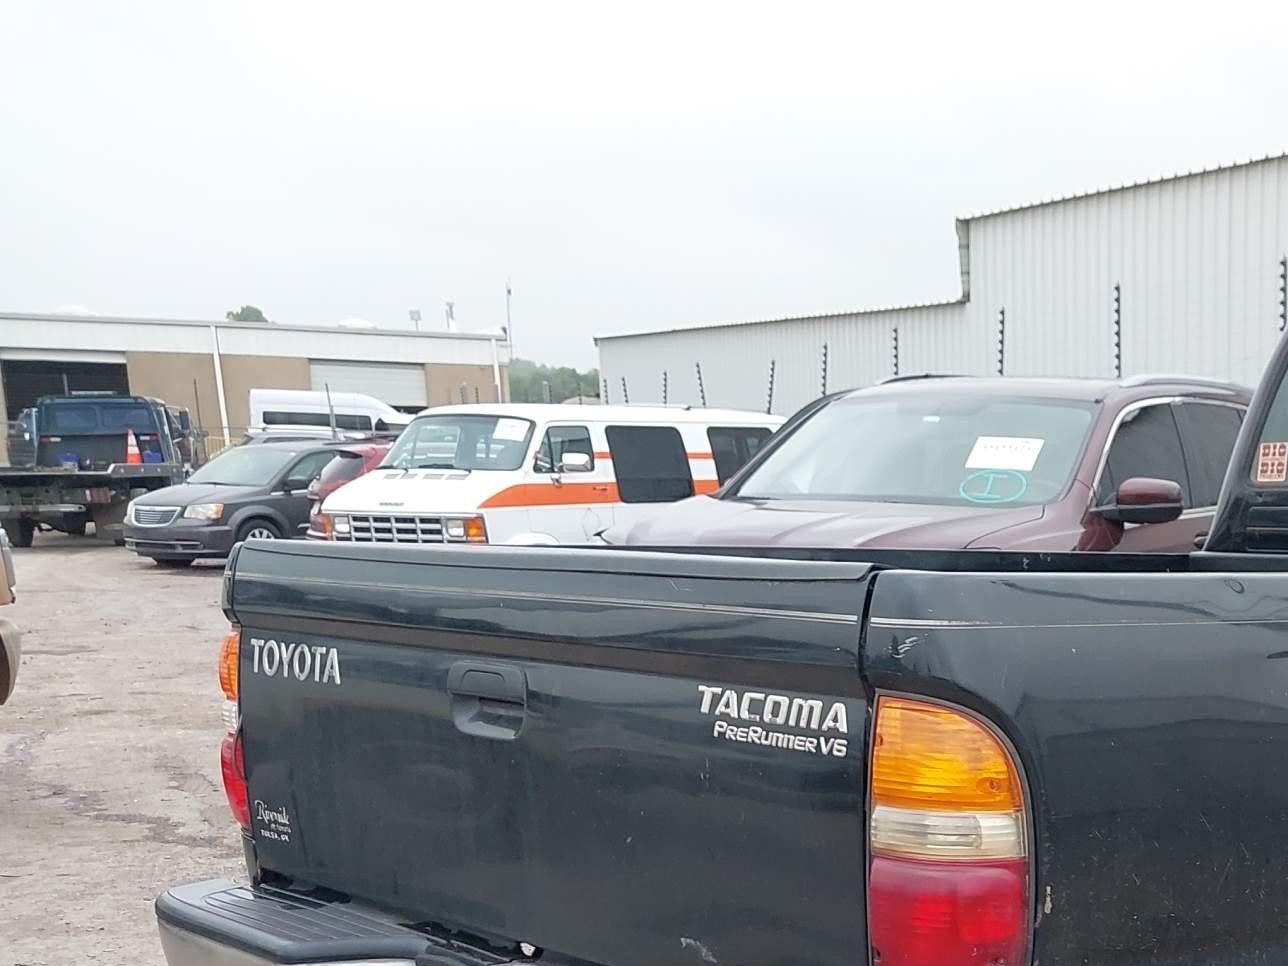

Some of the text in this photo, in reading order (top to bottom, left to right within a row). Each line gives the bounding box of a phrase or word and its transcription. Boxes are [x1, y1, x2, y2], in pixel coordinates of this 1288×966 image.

[250, 638, 341, 685] TOYOTA
[698, 685, 848, 733] TACOMA
[819, 737, 848, 757] V6
